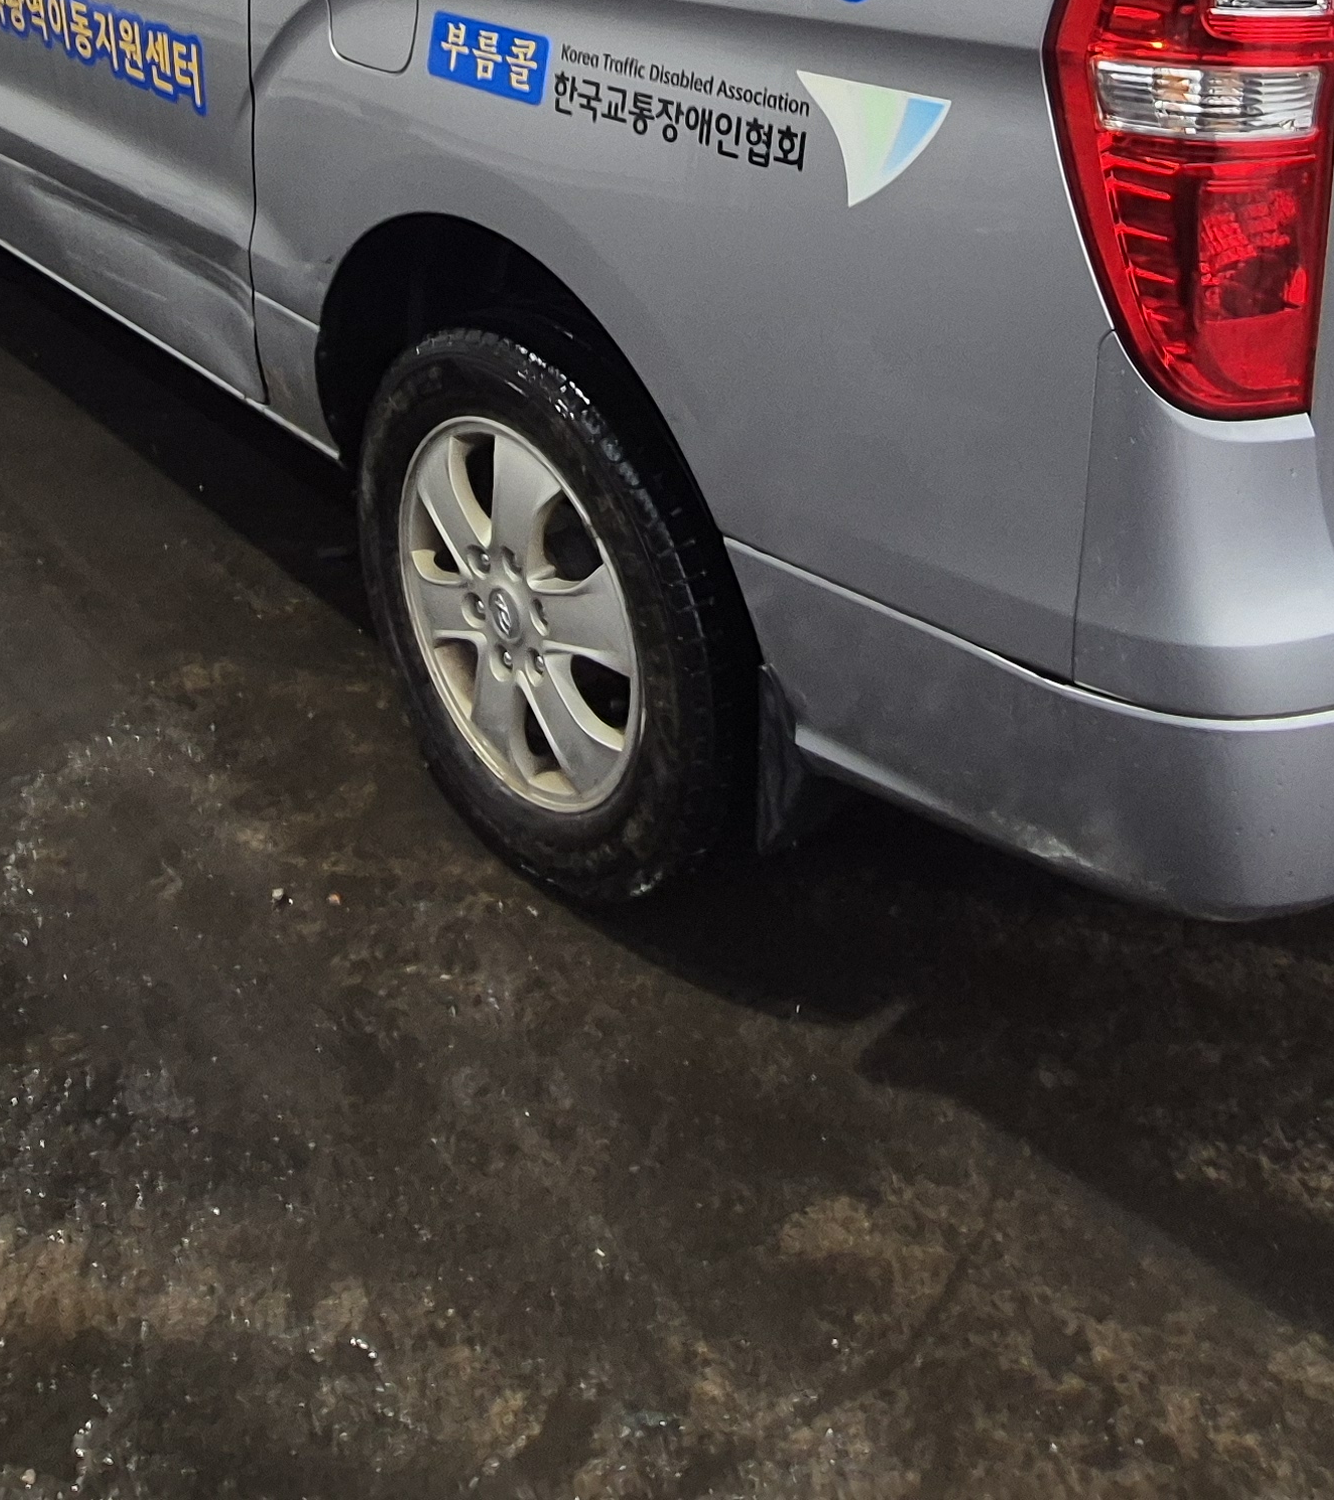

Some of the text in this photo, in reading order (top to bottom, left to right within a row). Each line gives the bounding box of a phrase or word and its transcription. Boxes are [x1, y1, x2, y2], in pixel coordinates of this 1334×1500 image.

[441, 21, 539, 92] 부름콜
[560, 43, 811, 117] Korea Traffic Disabled Association
[553, 70, 808, 171] 한국교통장애인협회
